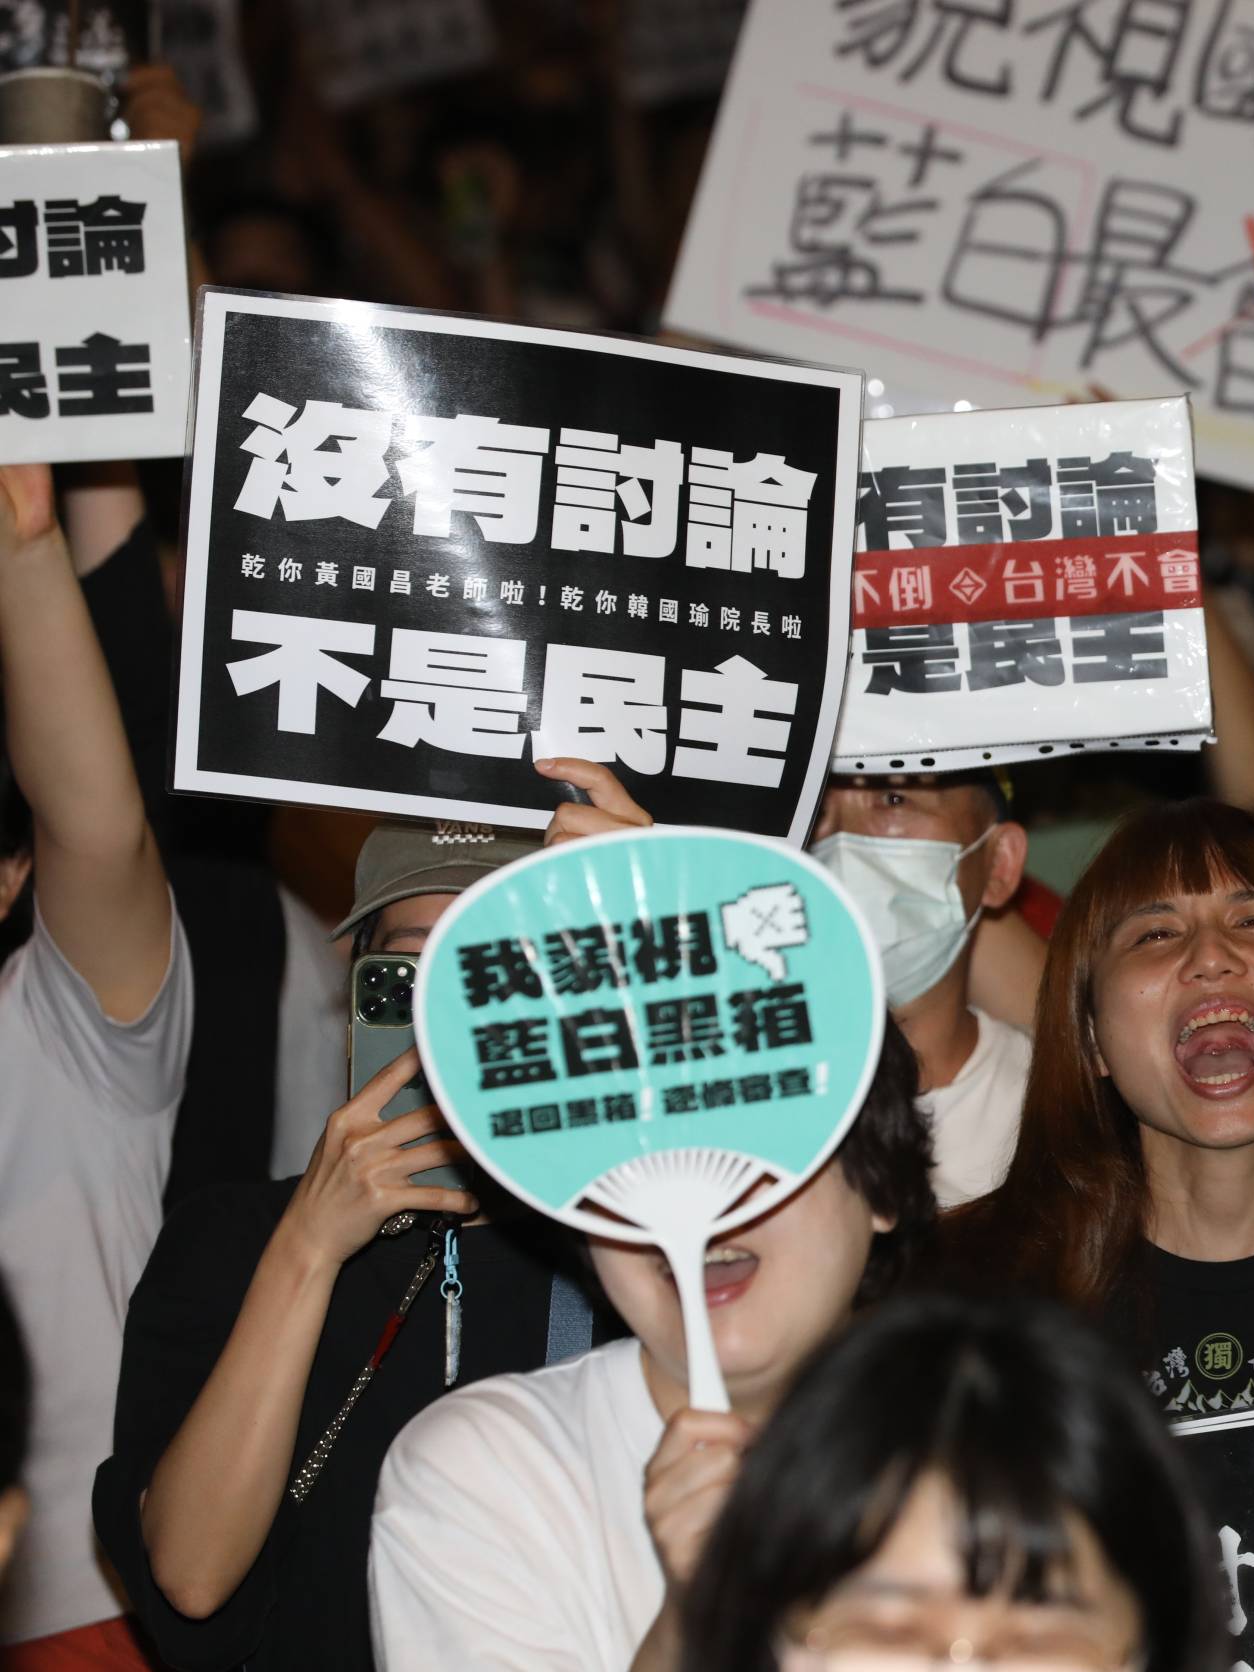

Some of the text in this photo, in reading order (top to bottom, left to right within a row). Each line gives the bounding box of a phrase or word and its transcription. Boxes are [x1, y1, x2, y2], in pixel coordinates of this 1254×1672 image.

[233, 392, 817, 579] 沒有討論
[225, 609, 799, 788] 不是民主
[473, 983, 813, 1090] 藍白黑箱
